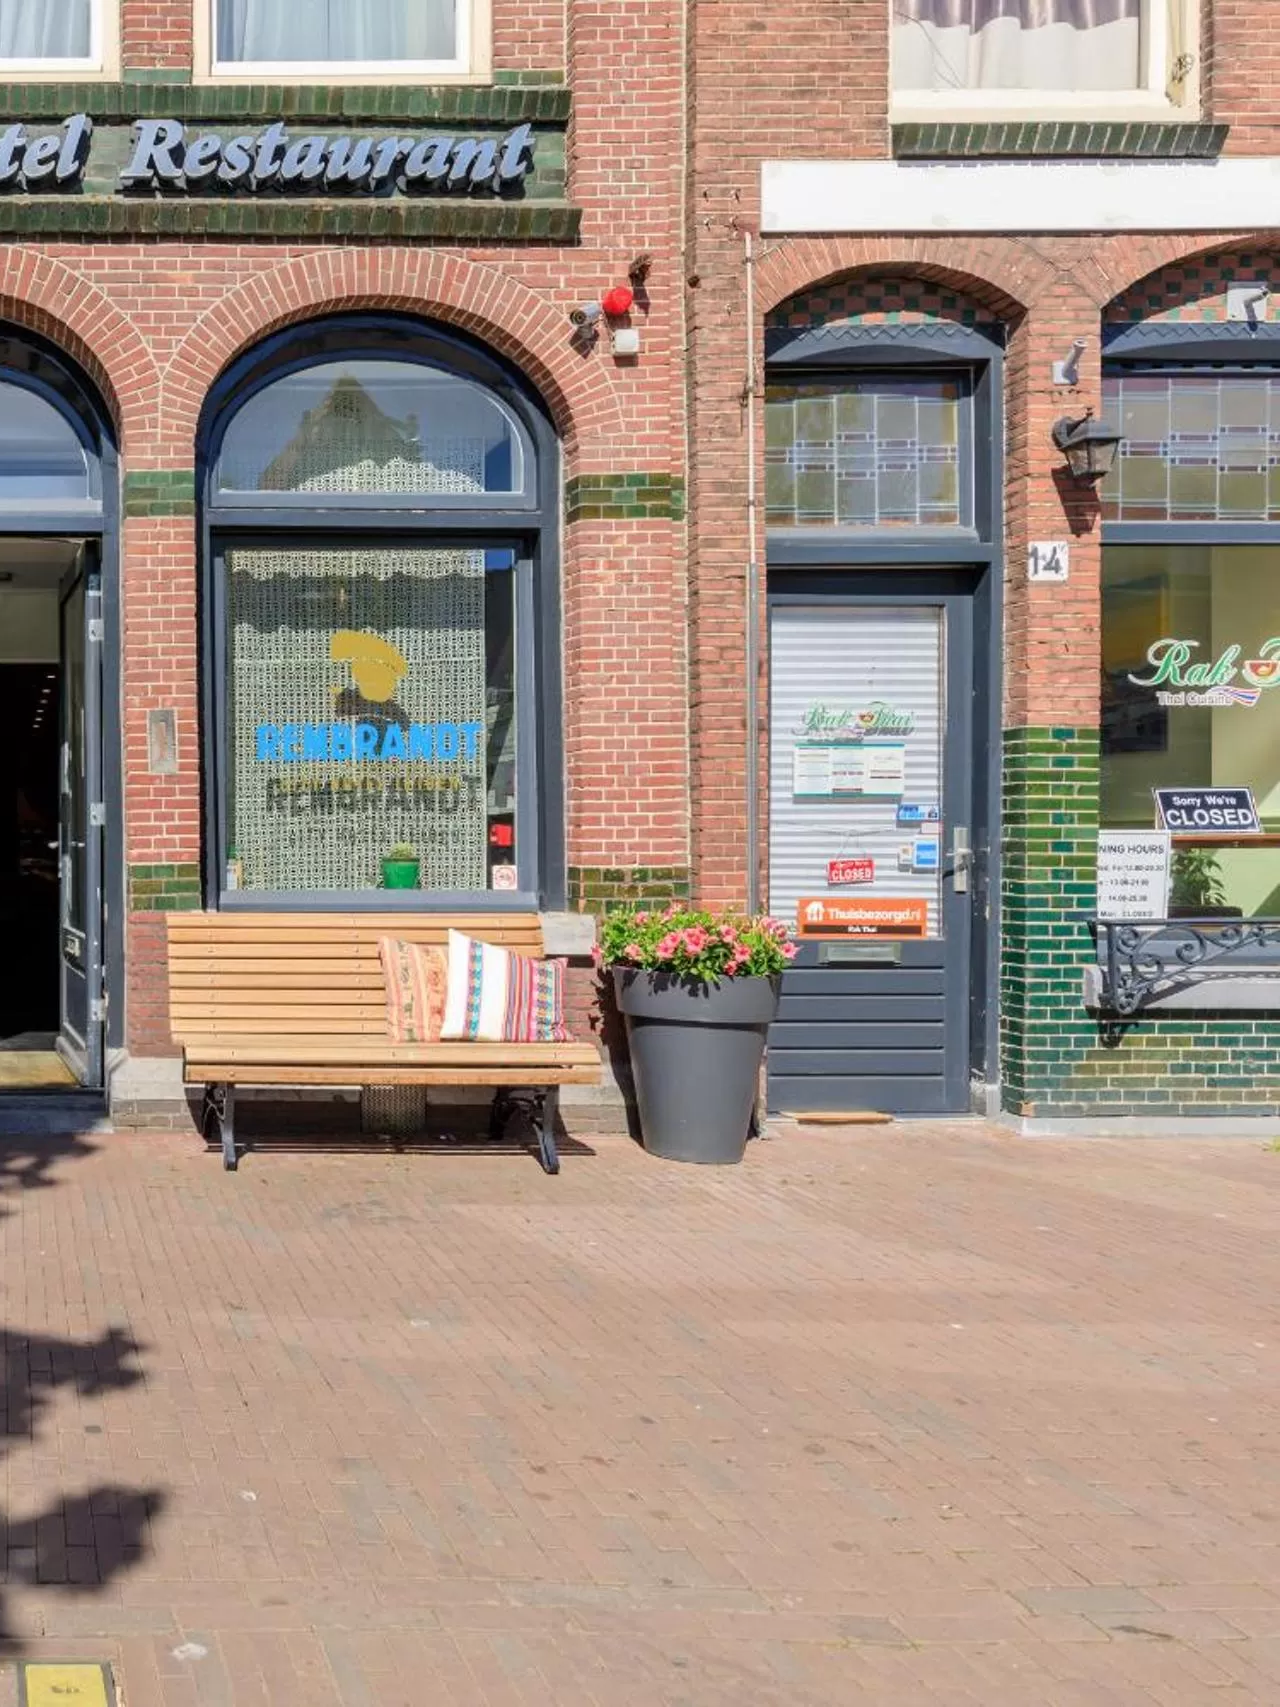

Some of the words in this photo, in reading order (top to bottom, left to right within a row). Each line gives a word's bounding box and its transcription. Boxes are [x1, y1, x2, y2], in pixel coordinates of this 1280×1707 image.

[119, 118, 538, 181] Restaurant
[1030, 545, 1062, 575] 14
[1127, 638, 1241, 687] Rak
[256, 722, 481, 762] REMBRANDT
[1172, 796, 1201, 807] Sorry
[1204, 794, 1237, 806] We're
[1166, 808, 1253, 826] CLOSED
[1127, 844, 1165, 855] HOURS
[831, 867, 872, 880] CLOSED
